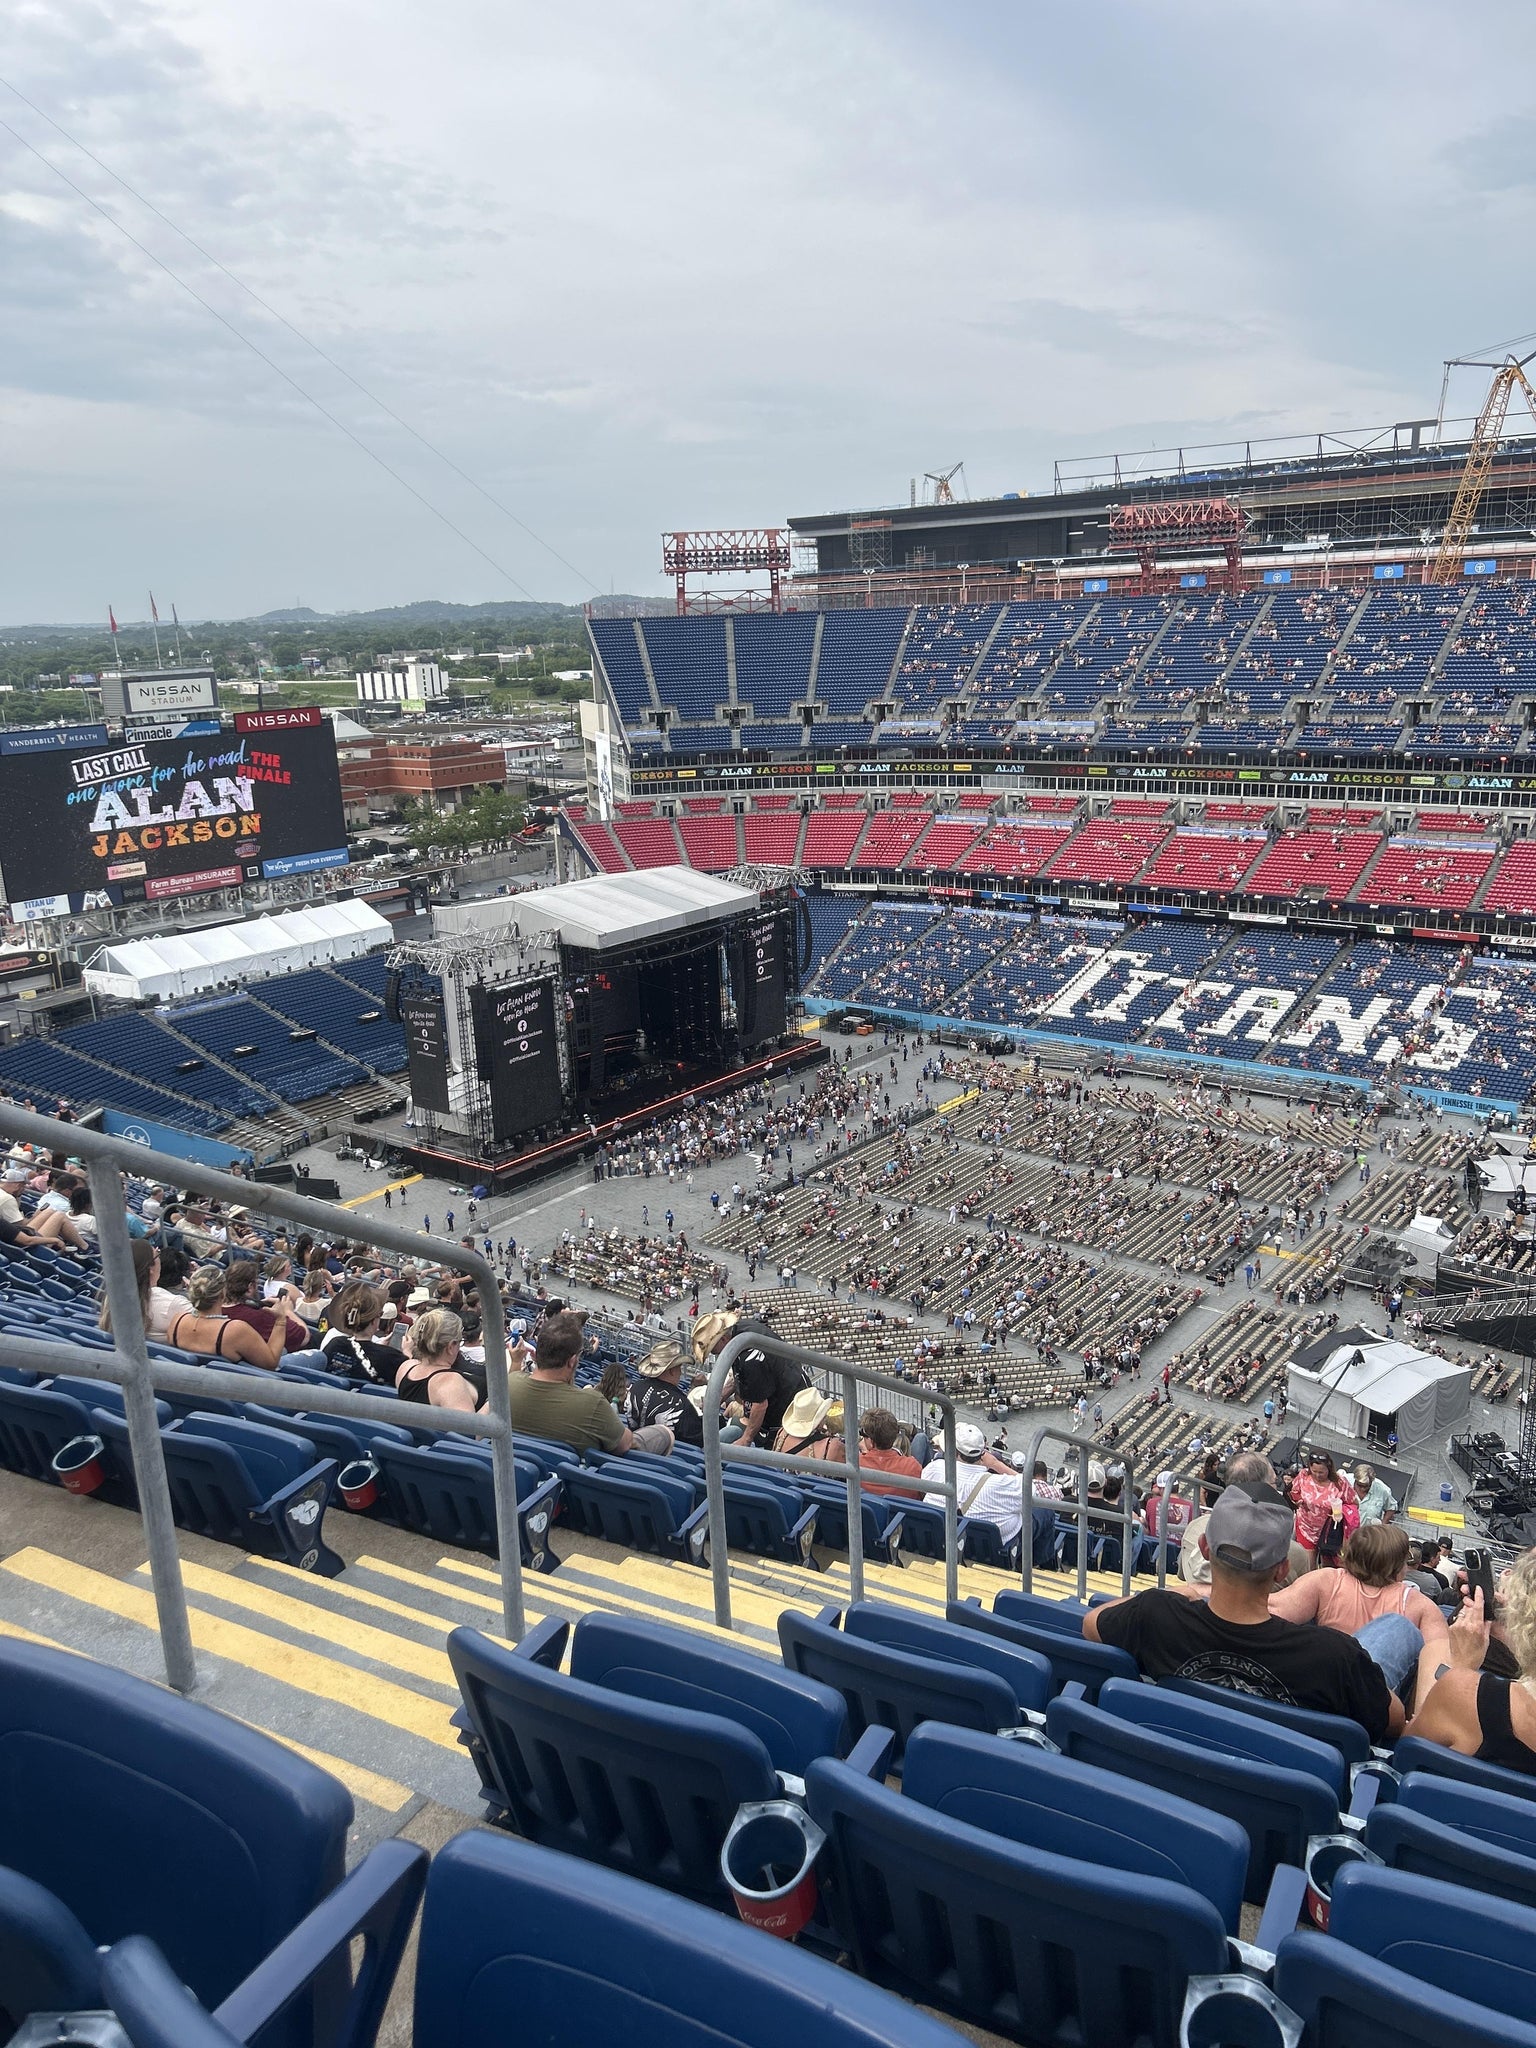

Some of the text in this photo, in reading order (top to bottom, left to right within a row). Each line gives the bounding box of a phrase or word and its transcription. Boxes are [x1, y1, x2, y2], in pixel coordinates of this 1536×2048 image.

[140, 684, 202, 697] NISSAN
[151, 696, 193, 706] STADIUM
[247, 712, 311, 727] NISSAN
[9, 736, 55, 748] VANDERBILT
[69, 733, 98, 742] HEALTH
[127, 726, 172, 742] Pinnacle
[72, 749, 150, 783] LAST CALL
[250, 751, 281, 768] THE
[67, 786, 98, 805] one
[101, 774, 146, 796] more
[151, 766, 176, 793] for
[181, 750, 206, 779] the
[237, 764, 291, 785] FINALE
[720, 767, 752, 776] ALAN
[756, 765, 812, 774] JACKSON
[859, 764, 891, 772] ALAN
[894, 763, 949, 771] JACKSON
[994, 764, 1025, 773] ALAN
[1133, 768, 1167, 777] ALAN
[1171, 768, 1235, 779] JACKSON
[1289, 772, 1328, 783] ALAN
[1333, 773, 1404, 784] JACKSON
[1468, 777, 1513, 788] ALAN
[89, 776, 256, 832] ALAN
[92, 812, 262, 857] JACKSON
[151, 868, 237, 889] Farm Bureau INSURANCE
[24, 897, 56, 910] TITAN UP
[524, 987, 542, 1003] KNOW
[301, 1552, 316, 1569] GG
